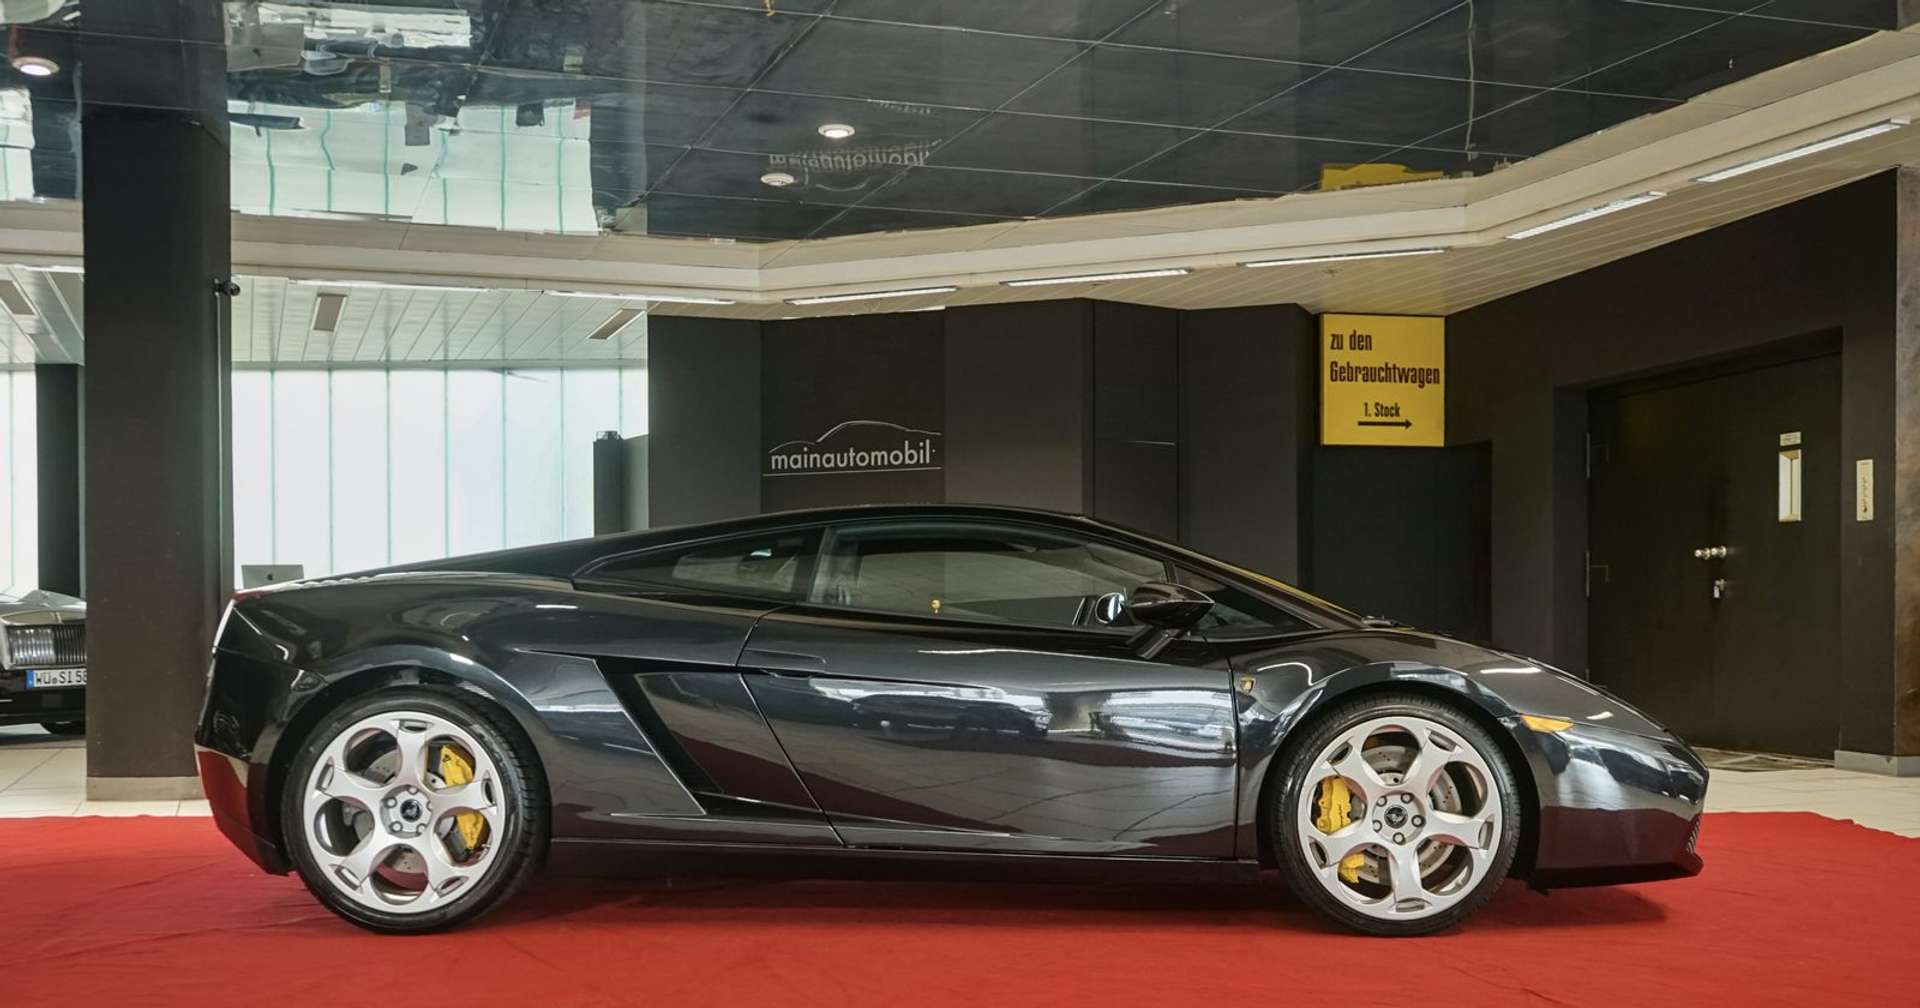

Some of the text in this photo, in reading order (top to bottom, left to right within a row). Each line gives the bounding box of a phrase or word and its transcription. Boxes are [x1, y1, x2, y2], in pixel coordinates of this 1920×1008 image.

[1330, 329, 1373, 351] zu den
[1330, 361, 1440, 389] Gebrauchtwagen
[1363, 402, 1400, 418] 1. Stock
[771, 439, 931, 470] mainautomobil
